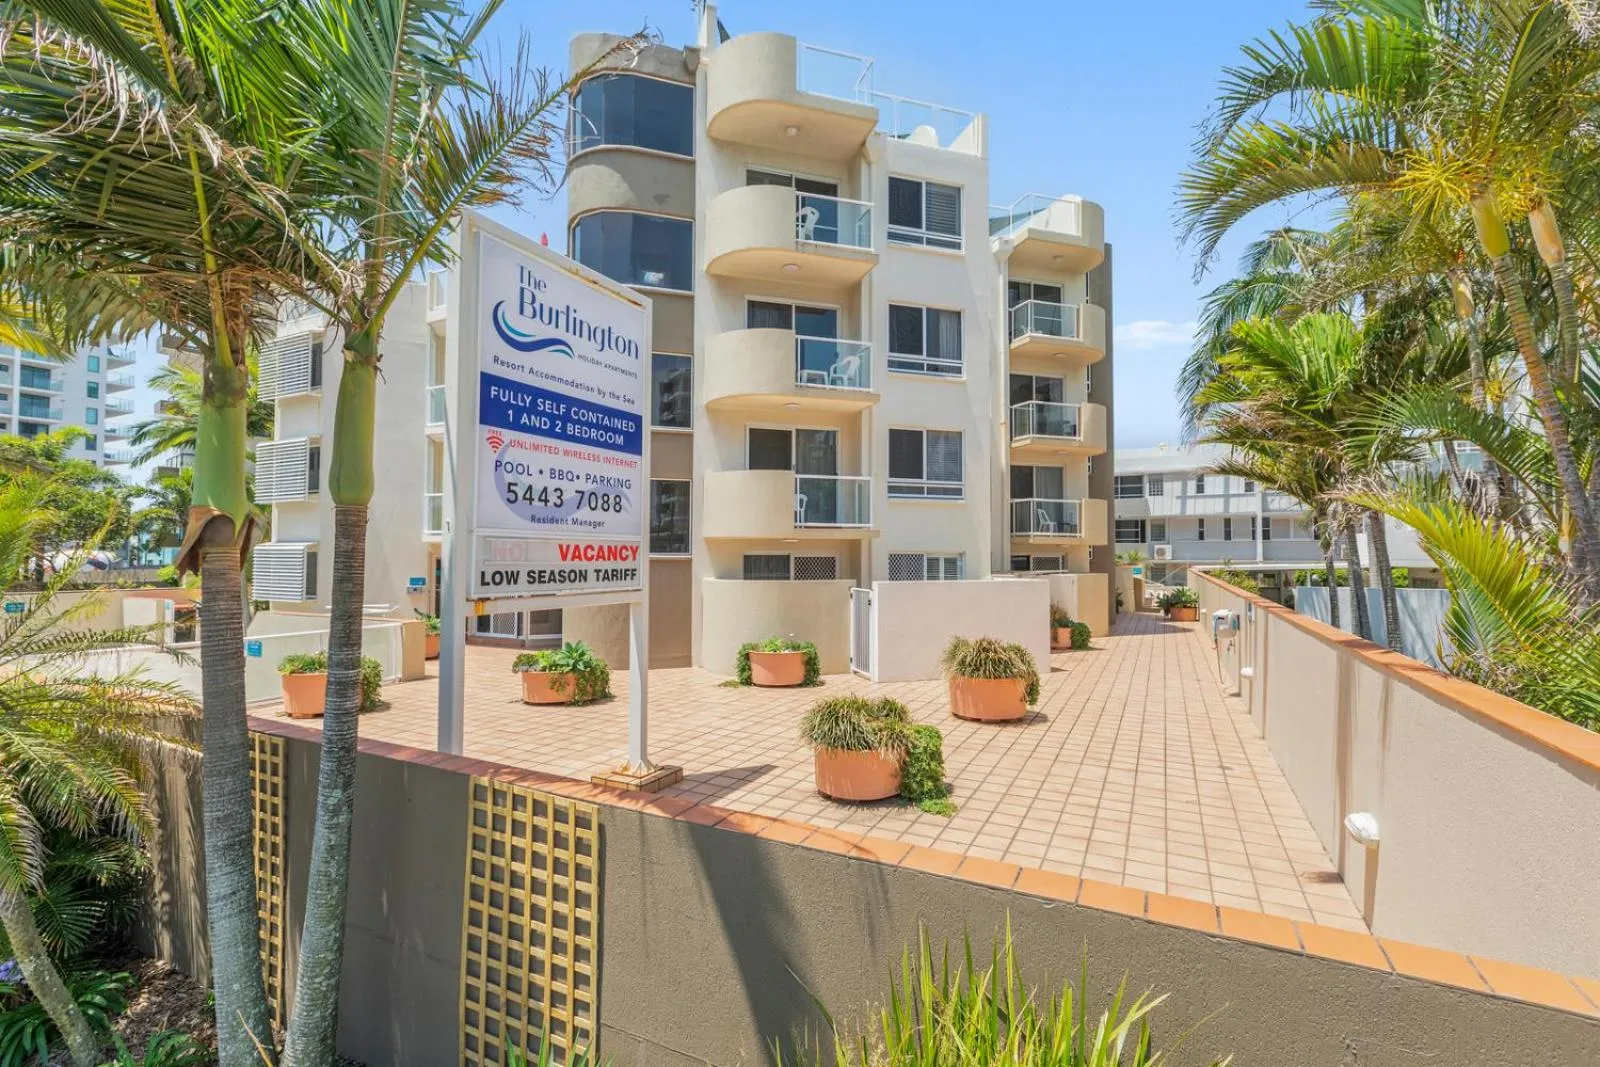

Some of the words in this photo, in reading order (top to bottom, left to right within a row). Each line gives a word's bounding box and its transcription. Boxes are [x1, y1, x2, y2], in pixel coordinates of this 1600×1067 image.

[518, 265, 547, 289] The
[519, 286, 639, 360] Burlington
[493, 355, 525, 371] Resort
[528, 366, 595, 393] Accommodation
[597, 388, 607, 399] by
[609, 390, 621, 401] the
[622, 394, 636, 405] Sea
[490, 386, 532, 407] FULLY
[537, 398, 567, 416] SELF
[570, 407, 636, 433] CONTAINED
[507, 410, 514, 423] 1
[520, 413, 550, 430] AND
[555, 420, 562, 433] 2
[566, 423, 624, 446] BEDROOM
[509, 437, 560, 455] UNLIMITED
[562, 449, 601, 463] WIRELESS
[603, 456, 638, 469] INTERNET
[494, 459, 533, 477] POOL
[585, 473, 632, 489] PARKING
[506, 481, 564, 508] 5443
[574, 490, 622, 513] 7088
[530, 514, 569, 527] Resident
[571, 517, 605, 529] Manager
[558, 543, 640, 562] VACANCY
[480, 571, 520, 587] LOW
[526, 569, 588, 585] SEASON
[594, 568, 638, 582] TARIFF
